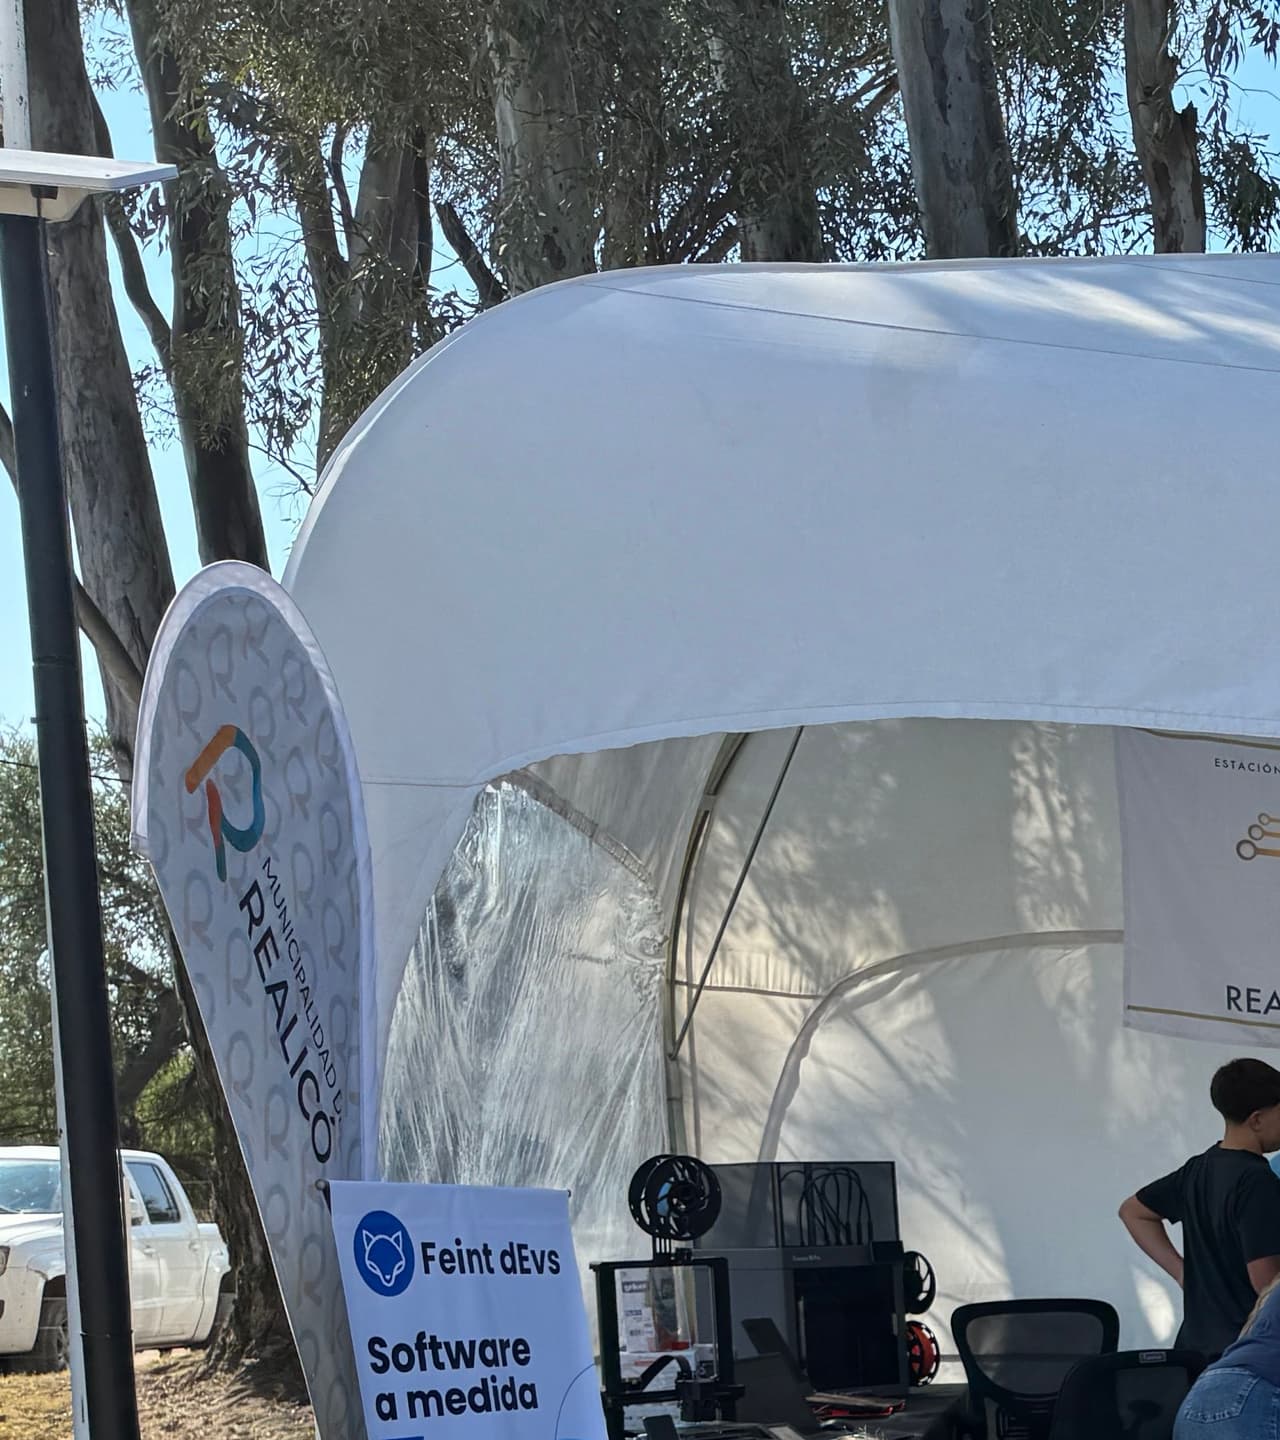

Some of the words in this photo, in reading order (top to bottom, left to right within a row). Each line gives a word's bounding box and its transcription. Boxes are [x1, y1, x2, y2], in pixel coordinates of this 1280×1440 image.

[261, 856, 338, 1089] MUNICIPALIDAD
[239, 879, 336, 1164] REALICÓ
[421, 1237, 494, 1275] Feint
[500, 1241, 561, 1275] dEvs
[368, 1330, 531, 1374] Software
[375, 1390, 398, 1421] a
[407, 1374, 538, 1419] medida
